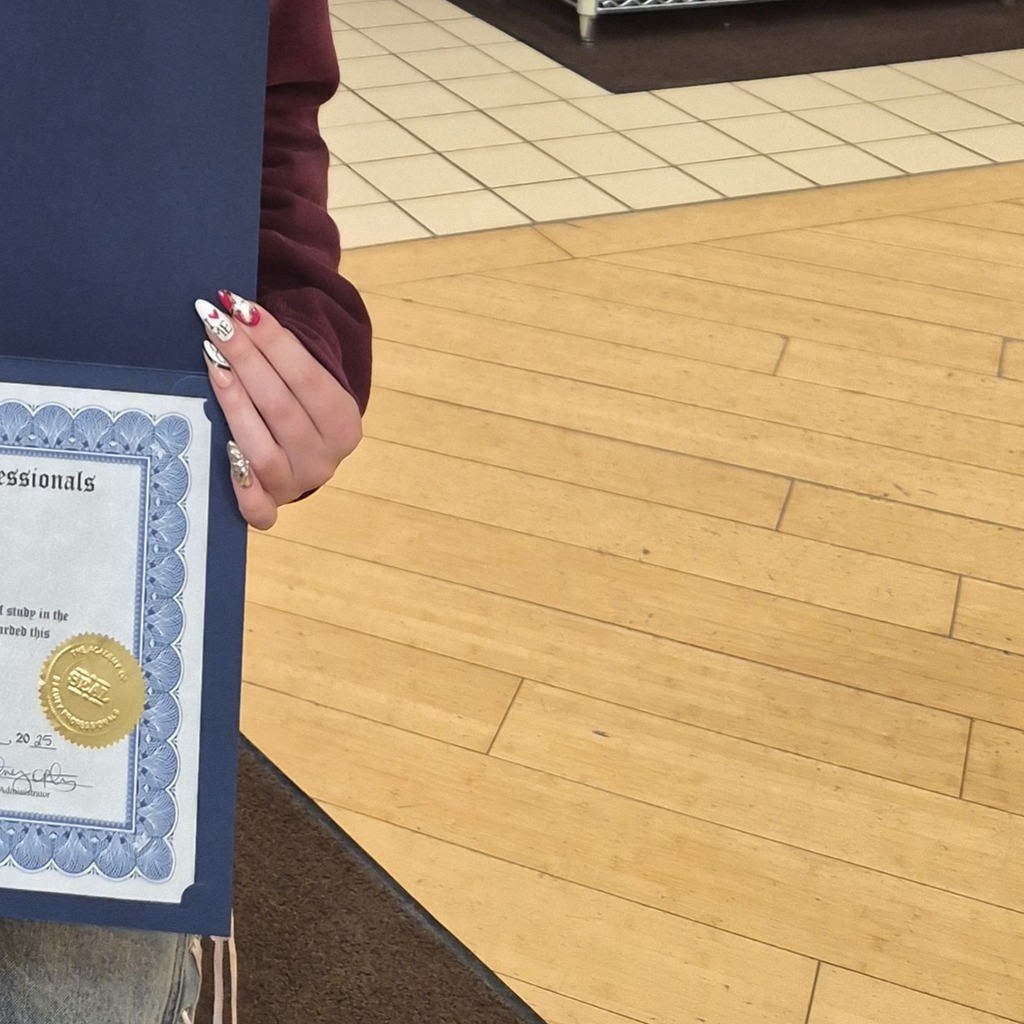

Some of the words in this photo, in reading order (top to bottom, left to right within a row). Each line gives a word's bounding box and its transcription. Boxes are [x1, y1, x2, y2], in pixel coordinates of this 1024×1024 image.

[7, 606, 36, 621] study
[39, 608, 50, 620] in
[53, 610, 69, 623] the
[30, 626, 50, 640] this
